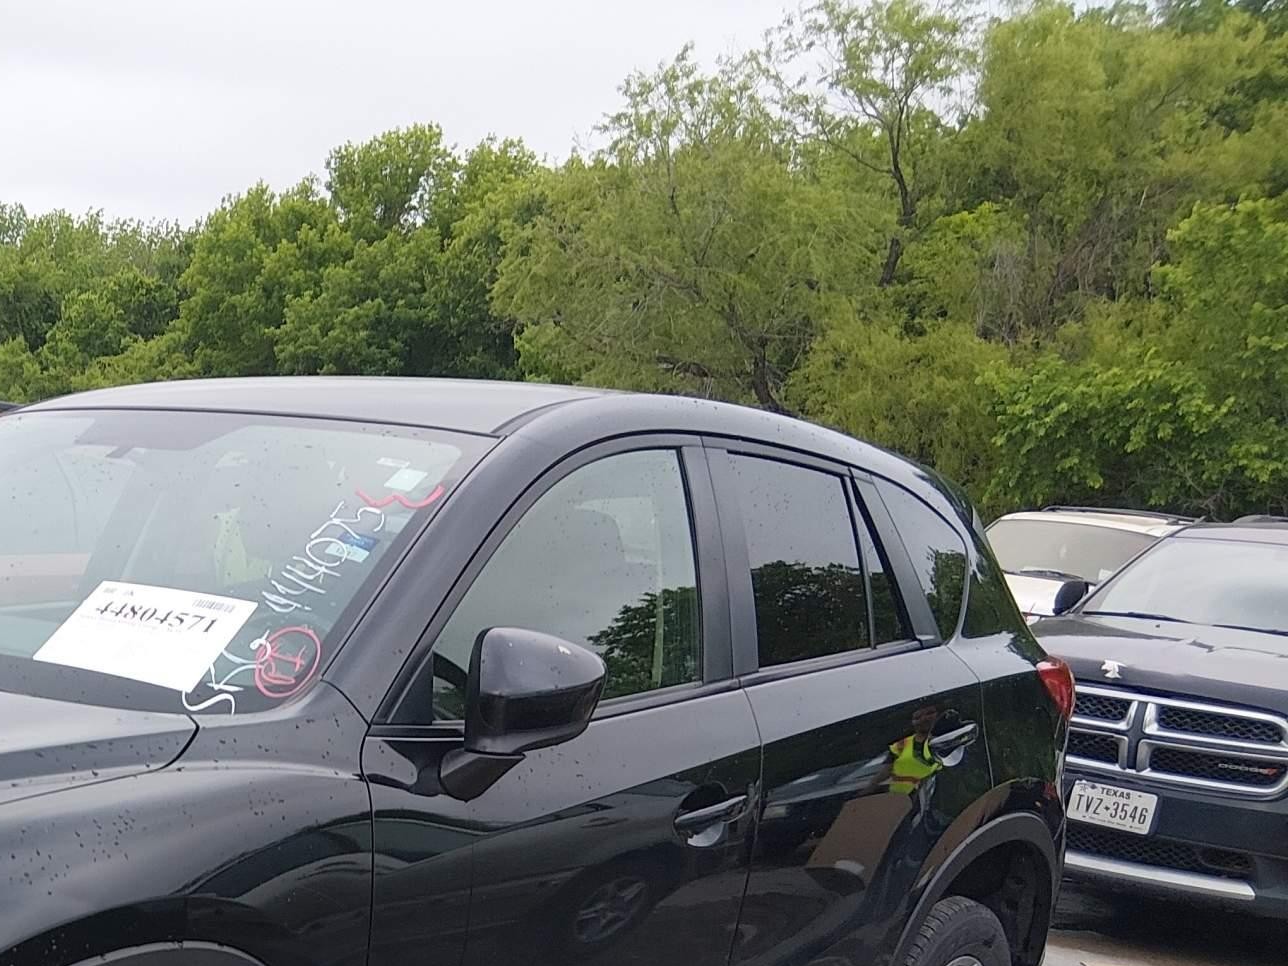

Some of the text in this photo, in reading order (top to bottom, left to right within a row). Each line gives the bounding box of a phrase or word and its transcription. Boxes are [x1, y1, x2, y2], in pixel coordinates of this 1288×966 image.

[95, 600, 218, 633] 44804571
[1218, 763, 1269, 775] DODGE
[1100, 786, 1131, 800] TEXAS
